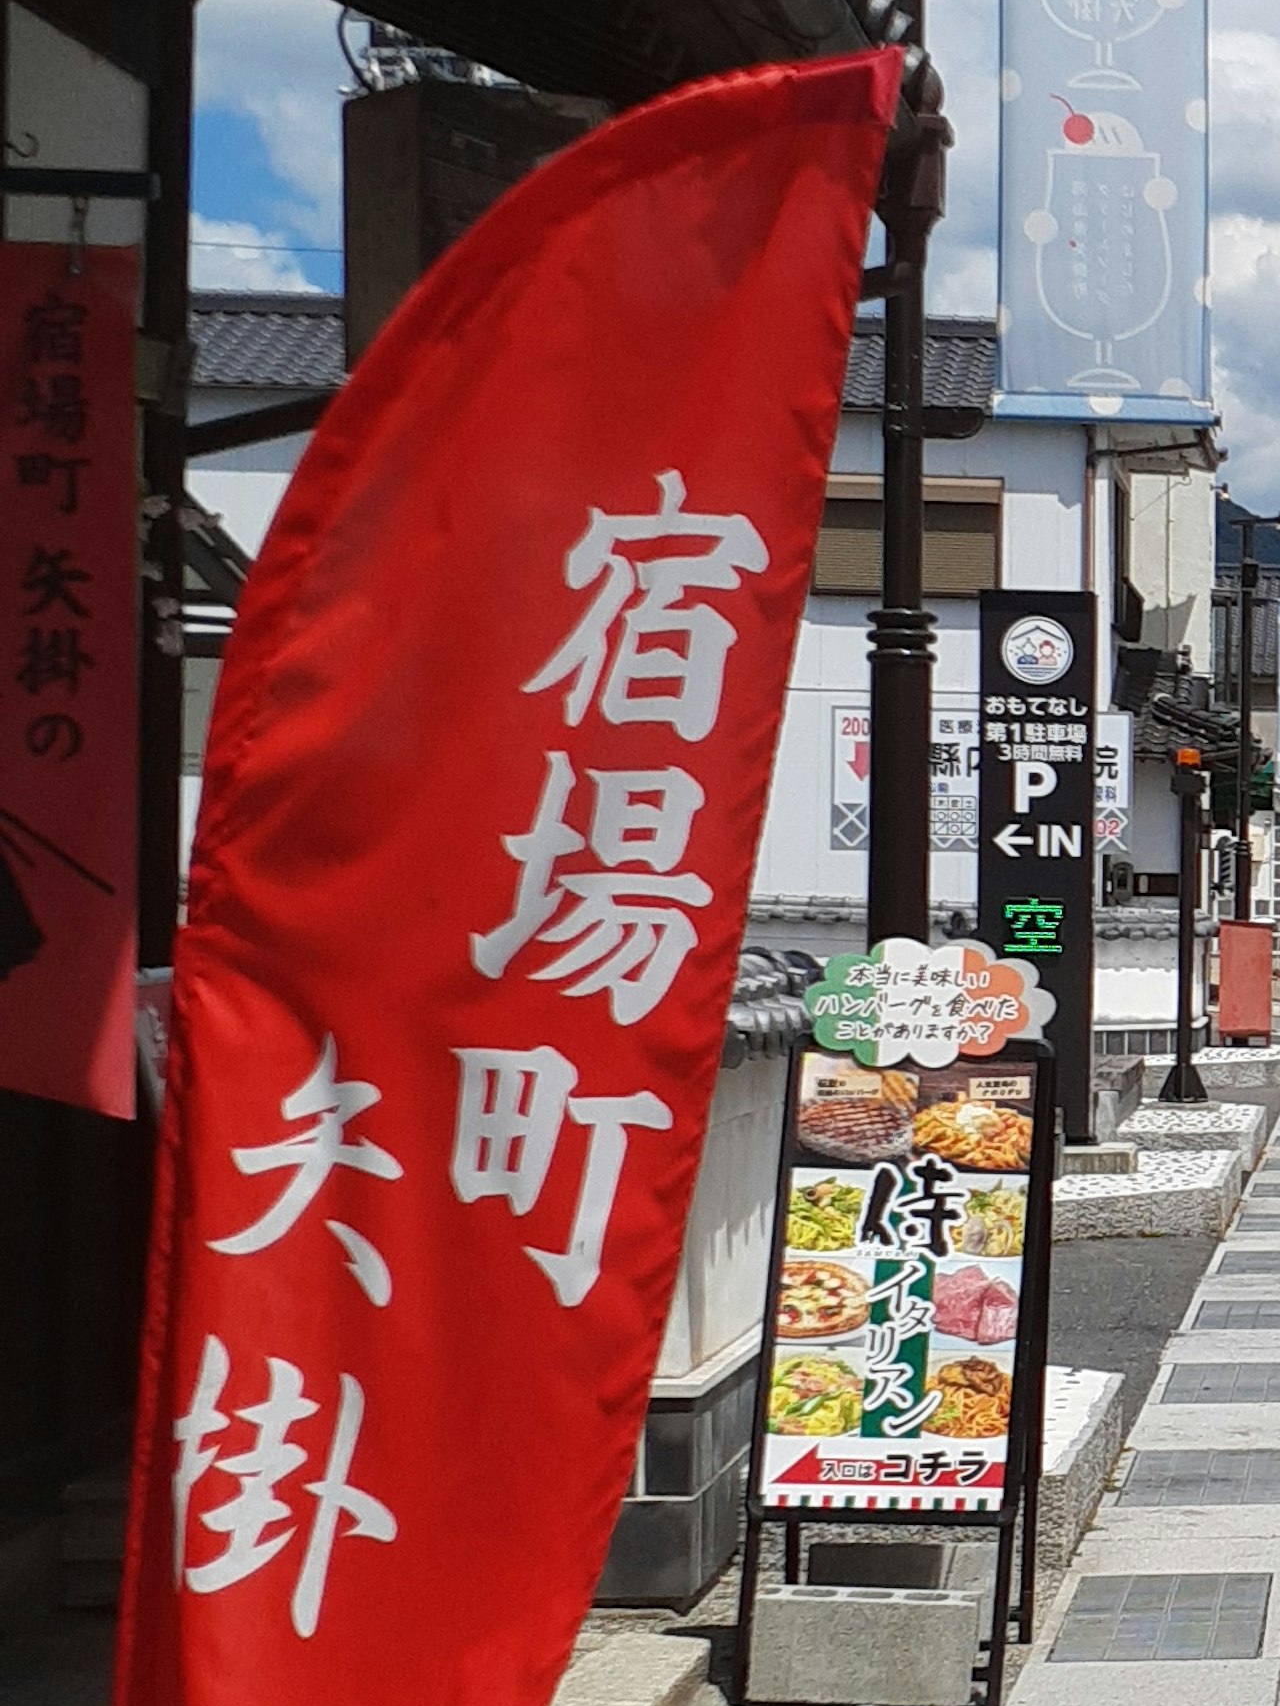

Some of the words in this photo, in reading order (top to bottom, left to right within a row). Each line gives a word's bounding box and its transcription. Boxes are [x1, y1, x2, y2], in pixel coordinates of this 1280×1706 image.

[14, 293, 92, 516] 宿場町
[16, 544, 94, 763] 矢掛の
[985, 697, 1088, 716] おもてなし
[939, 720, 980, 734] 医療
[984, 723, 1088, 744] 第1駐車場
[998, 745, 1084, 762] 3時間無料
[1014, 762, 1058, 814] P
[1038, 824, 1082, 858] IN
[450, 467, 771, 1308] 宿場町
[1003, 898, 1064, 954] 空
[847, 965, 990, 988] 本当に美味しい
[815, 993, 1019, 1019] ハンバーグを食べた
[835, 1022, 993, 1041] ことがありますか?
[860, 1159, 966, 1256] 侍
[172, 1029, 404, 1639] 矢掛
[868, 1266, 940, 1433] イタリアン
[822, 1463, 875, 1480] 入口は
[883, 1450, 990, 1484] コチラ
